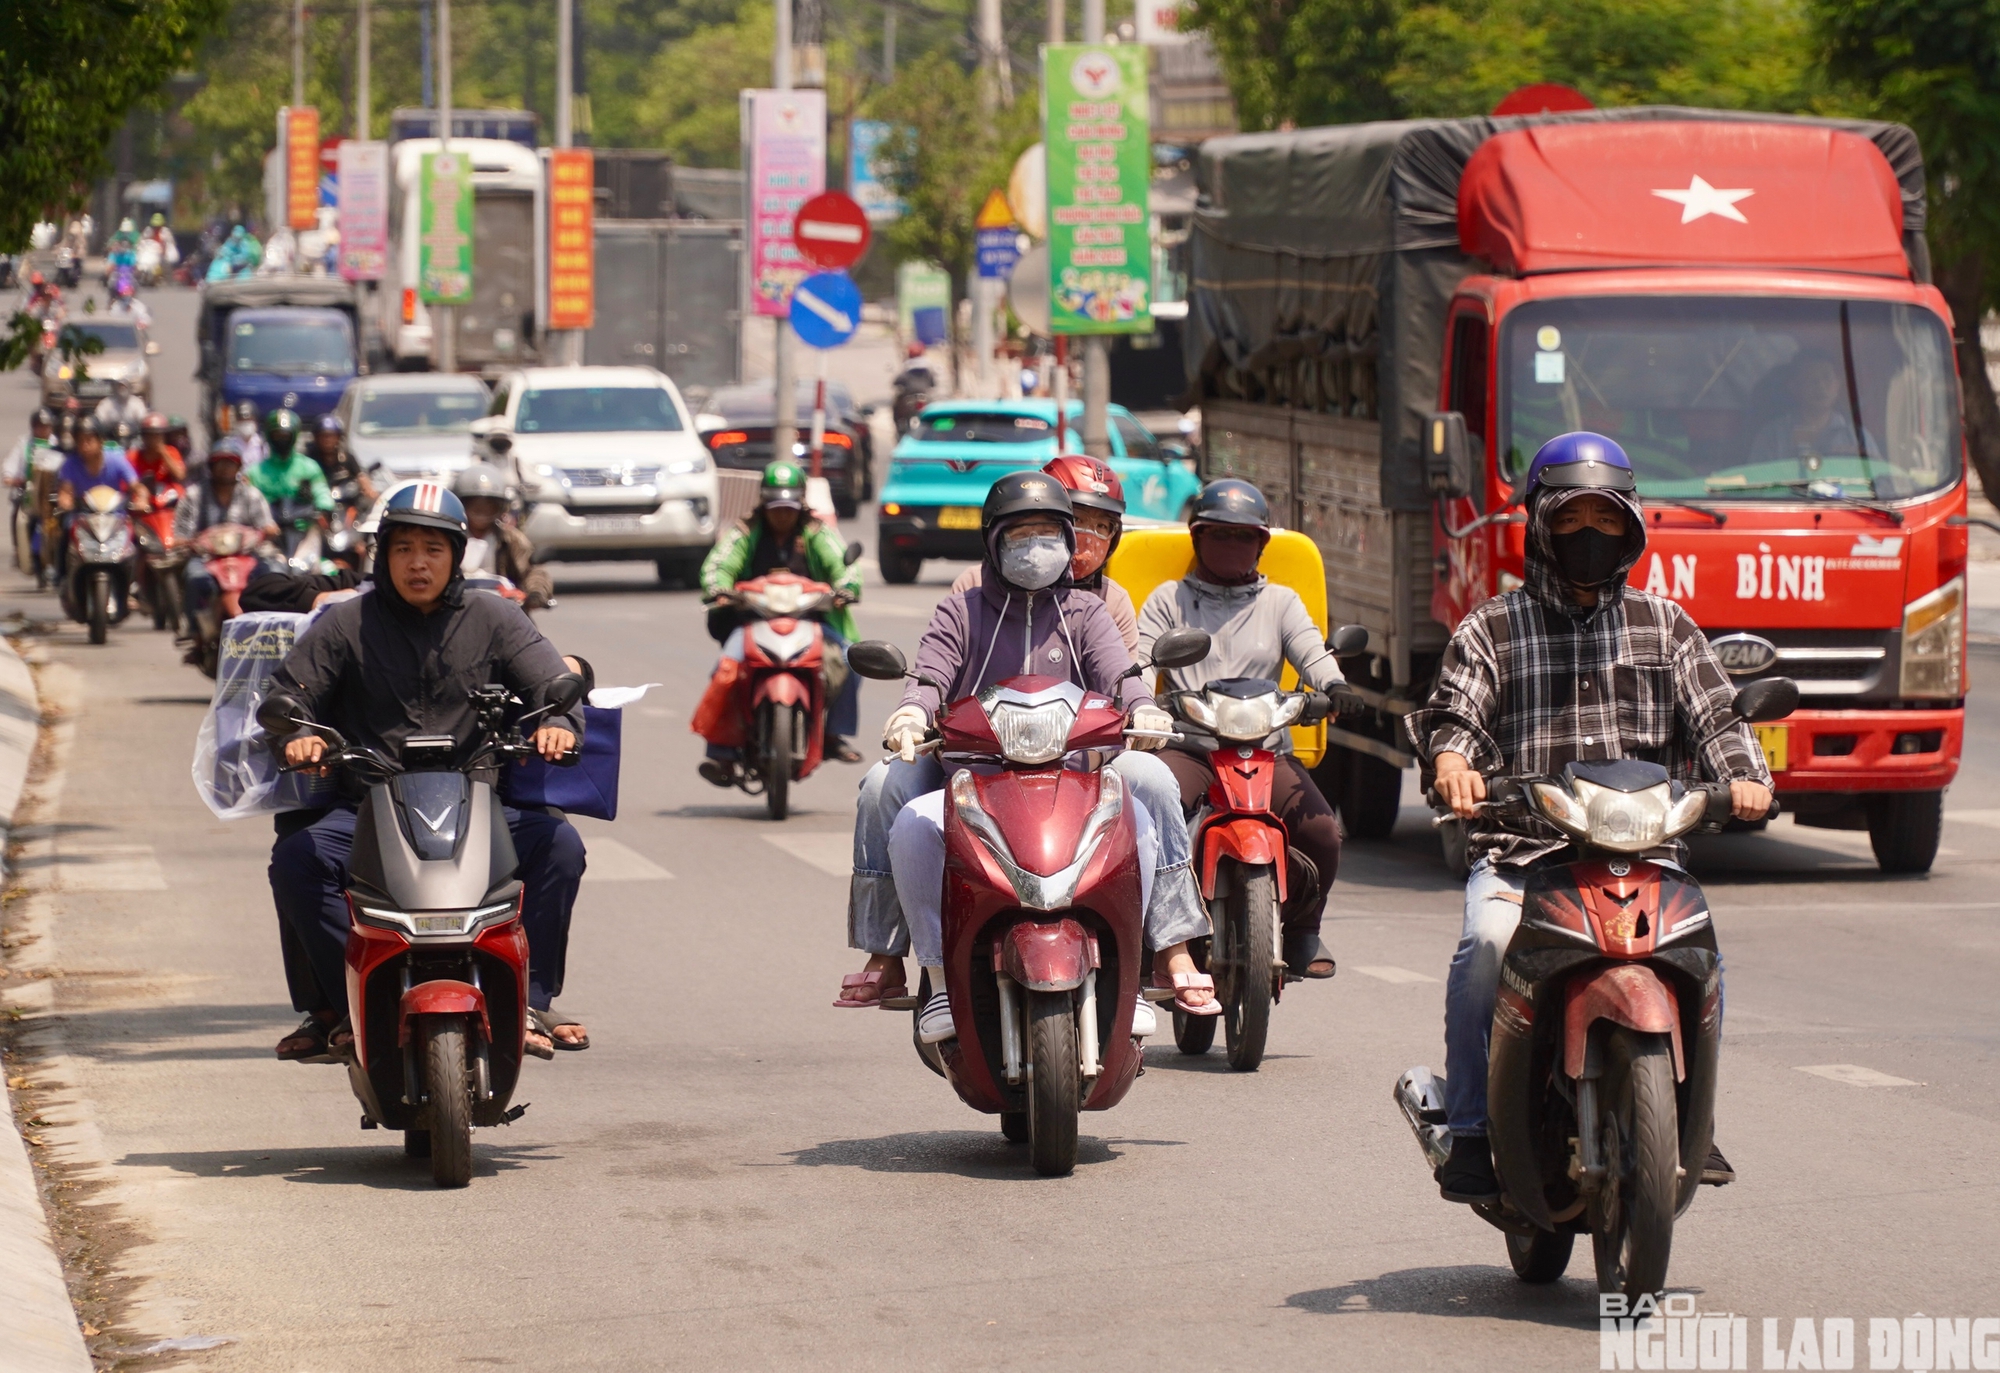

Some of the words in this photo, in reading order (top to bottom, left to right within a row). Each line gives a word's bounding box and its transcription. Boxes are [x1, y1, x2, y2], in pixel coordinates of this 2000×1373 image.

[1644, 552, 1697, 600] AN
[1736, 542, 1825, 601] BÌNH
[1502, 963, 1534, 1000] YAMAHA
